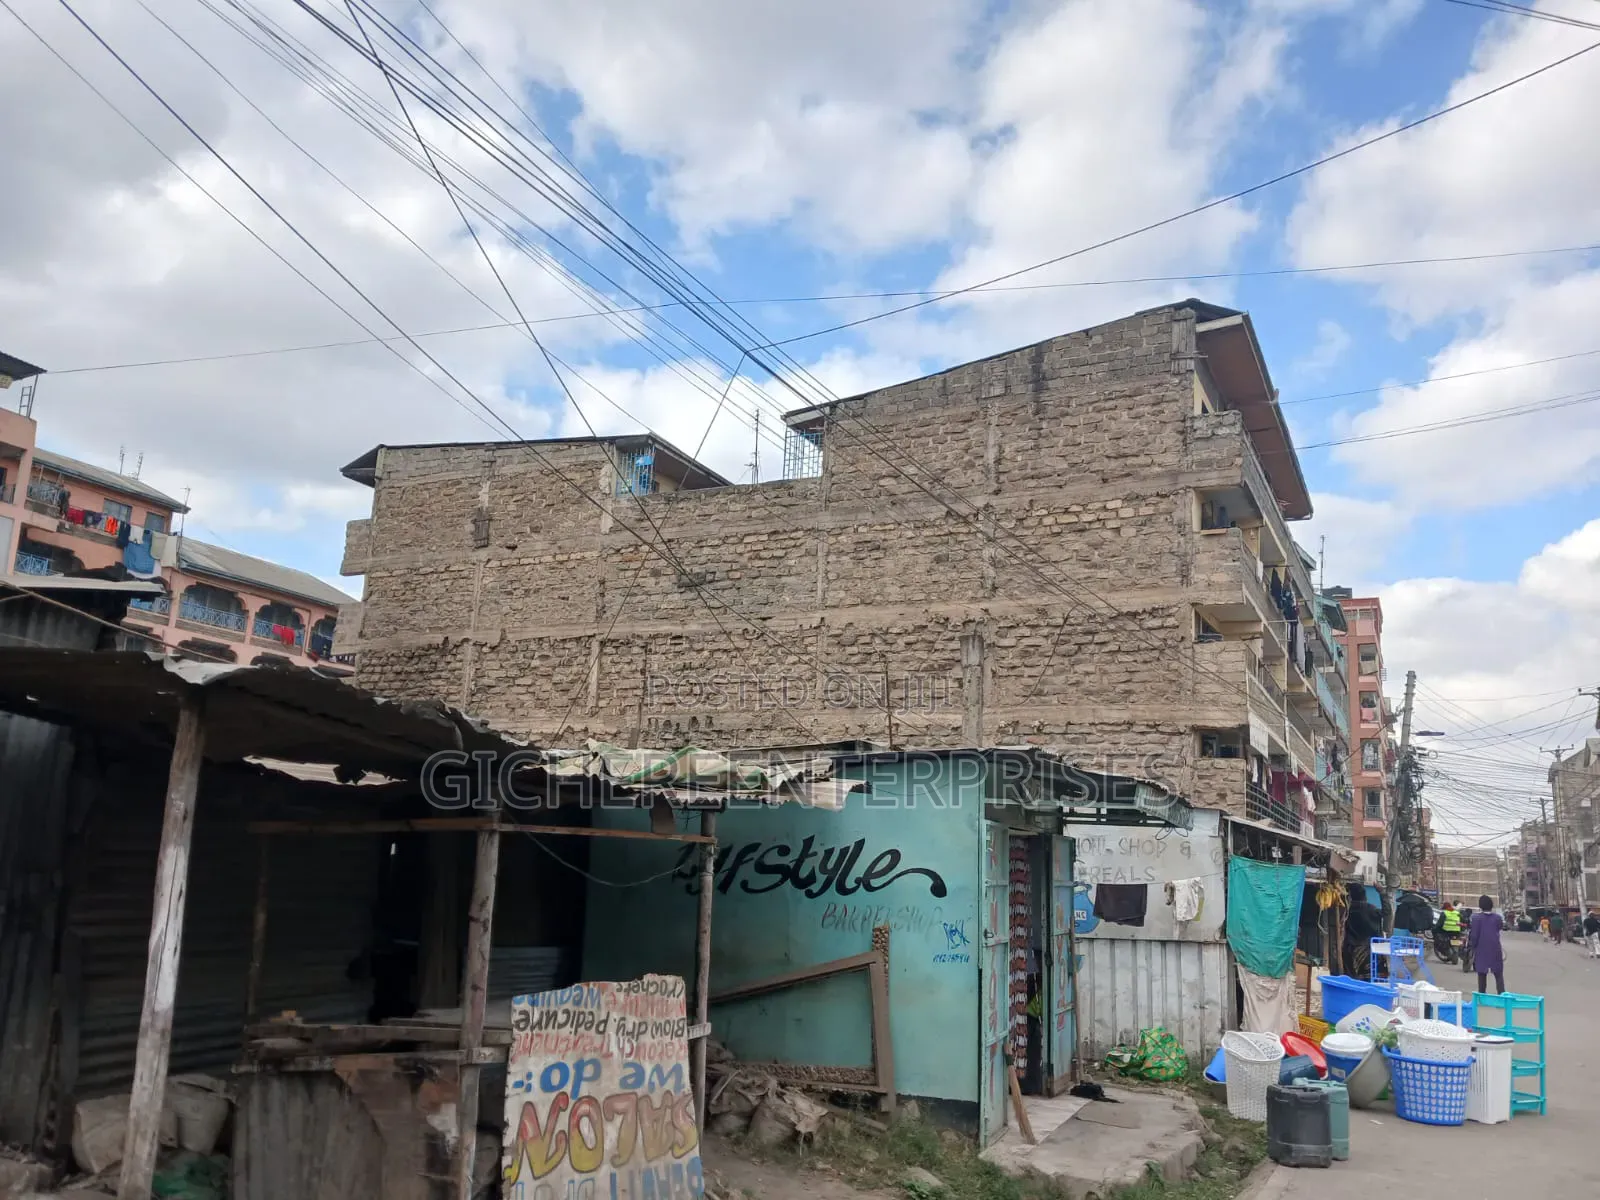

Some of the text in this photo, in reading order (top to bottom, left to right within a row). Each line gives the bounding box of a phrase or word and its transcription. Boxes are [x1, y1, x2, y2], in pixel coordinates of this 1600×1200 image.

[1118, 837, 1168, 859] SHOP
[650, 1017, 687, 1041] Blow
[503, 1091, 699, 1187] SALON
